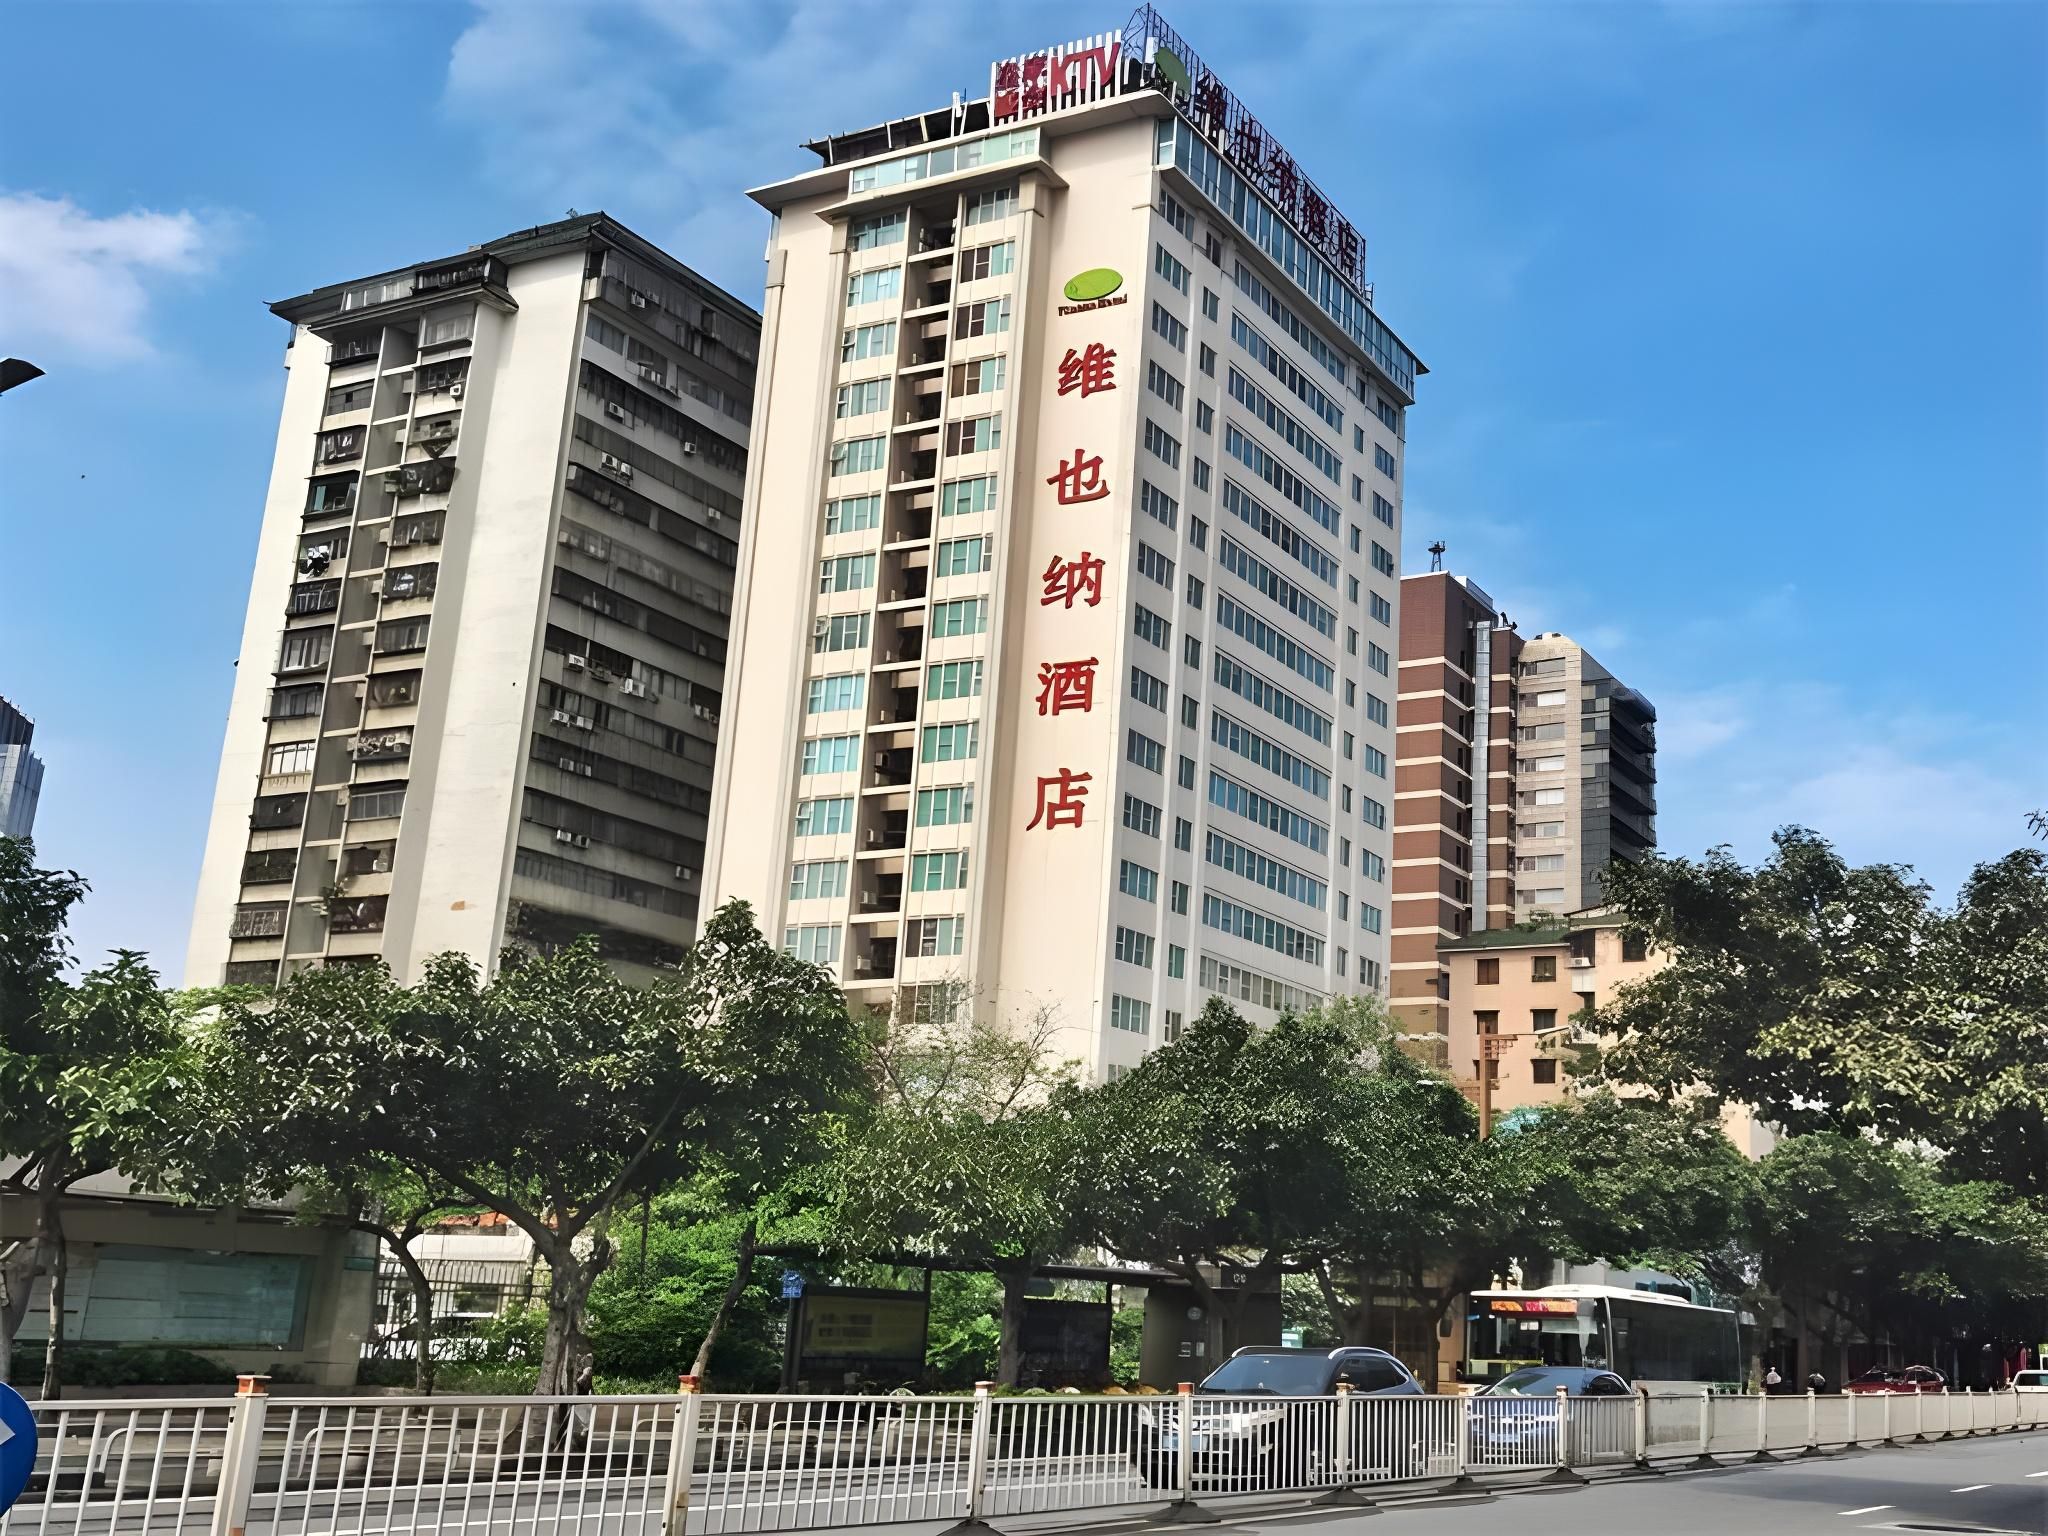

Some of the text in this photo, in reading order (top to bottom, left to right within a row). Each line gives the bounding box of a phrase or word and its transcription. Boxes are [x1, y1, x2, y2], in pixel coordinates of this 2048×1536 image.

[1051, 42, 1121, 96] KTV
[1026, 342, 1118, 832] 维也纳酒店
